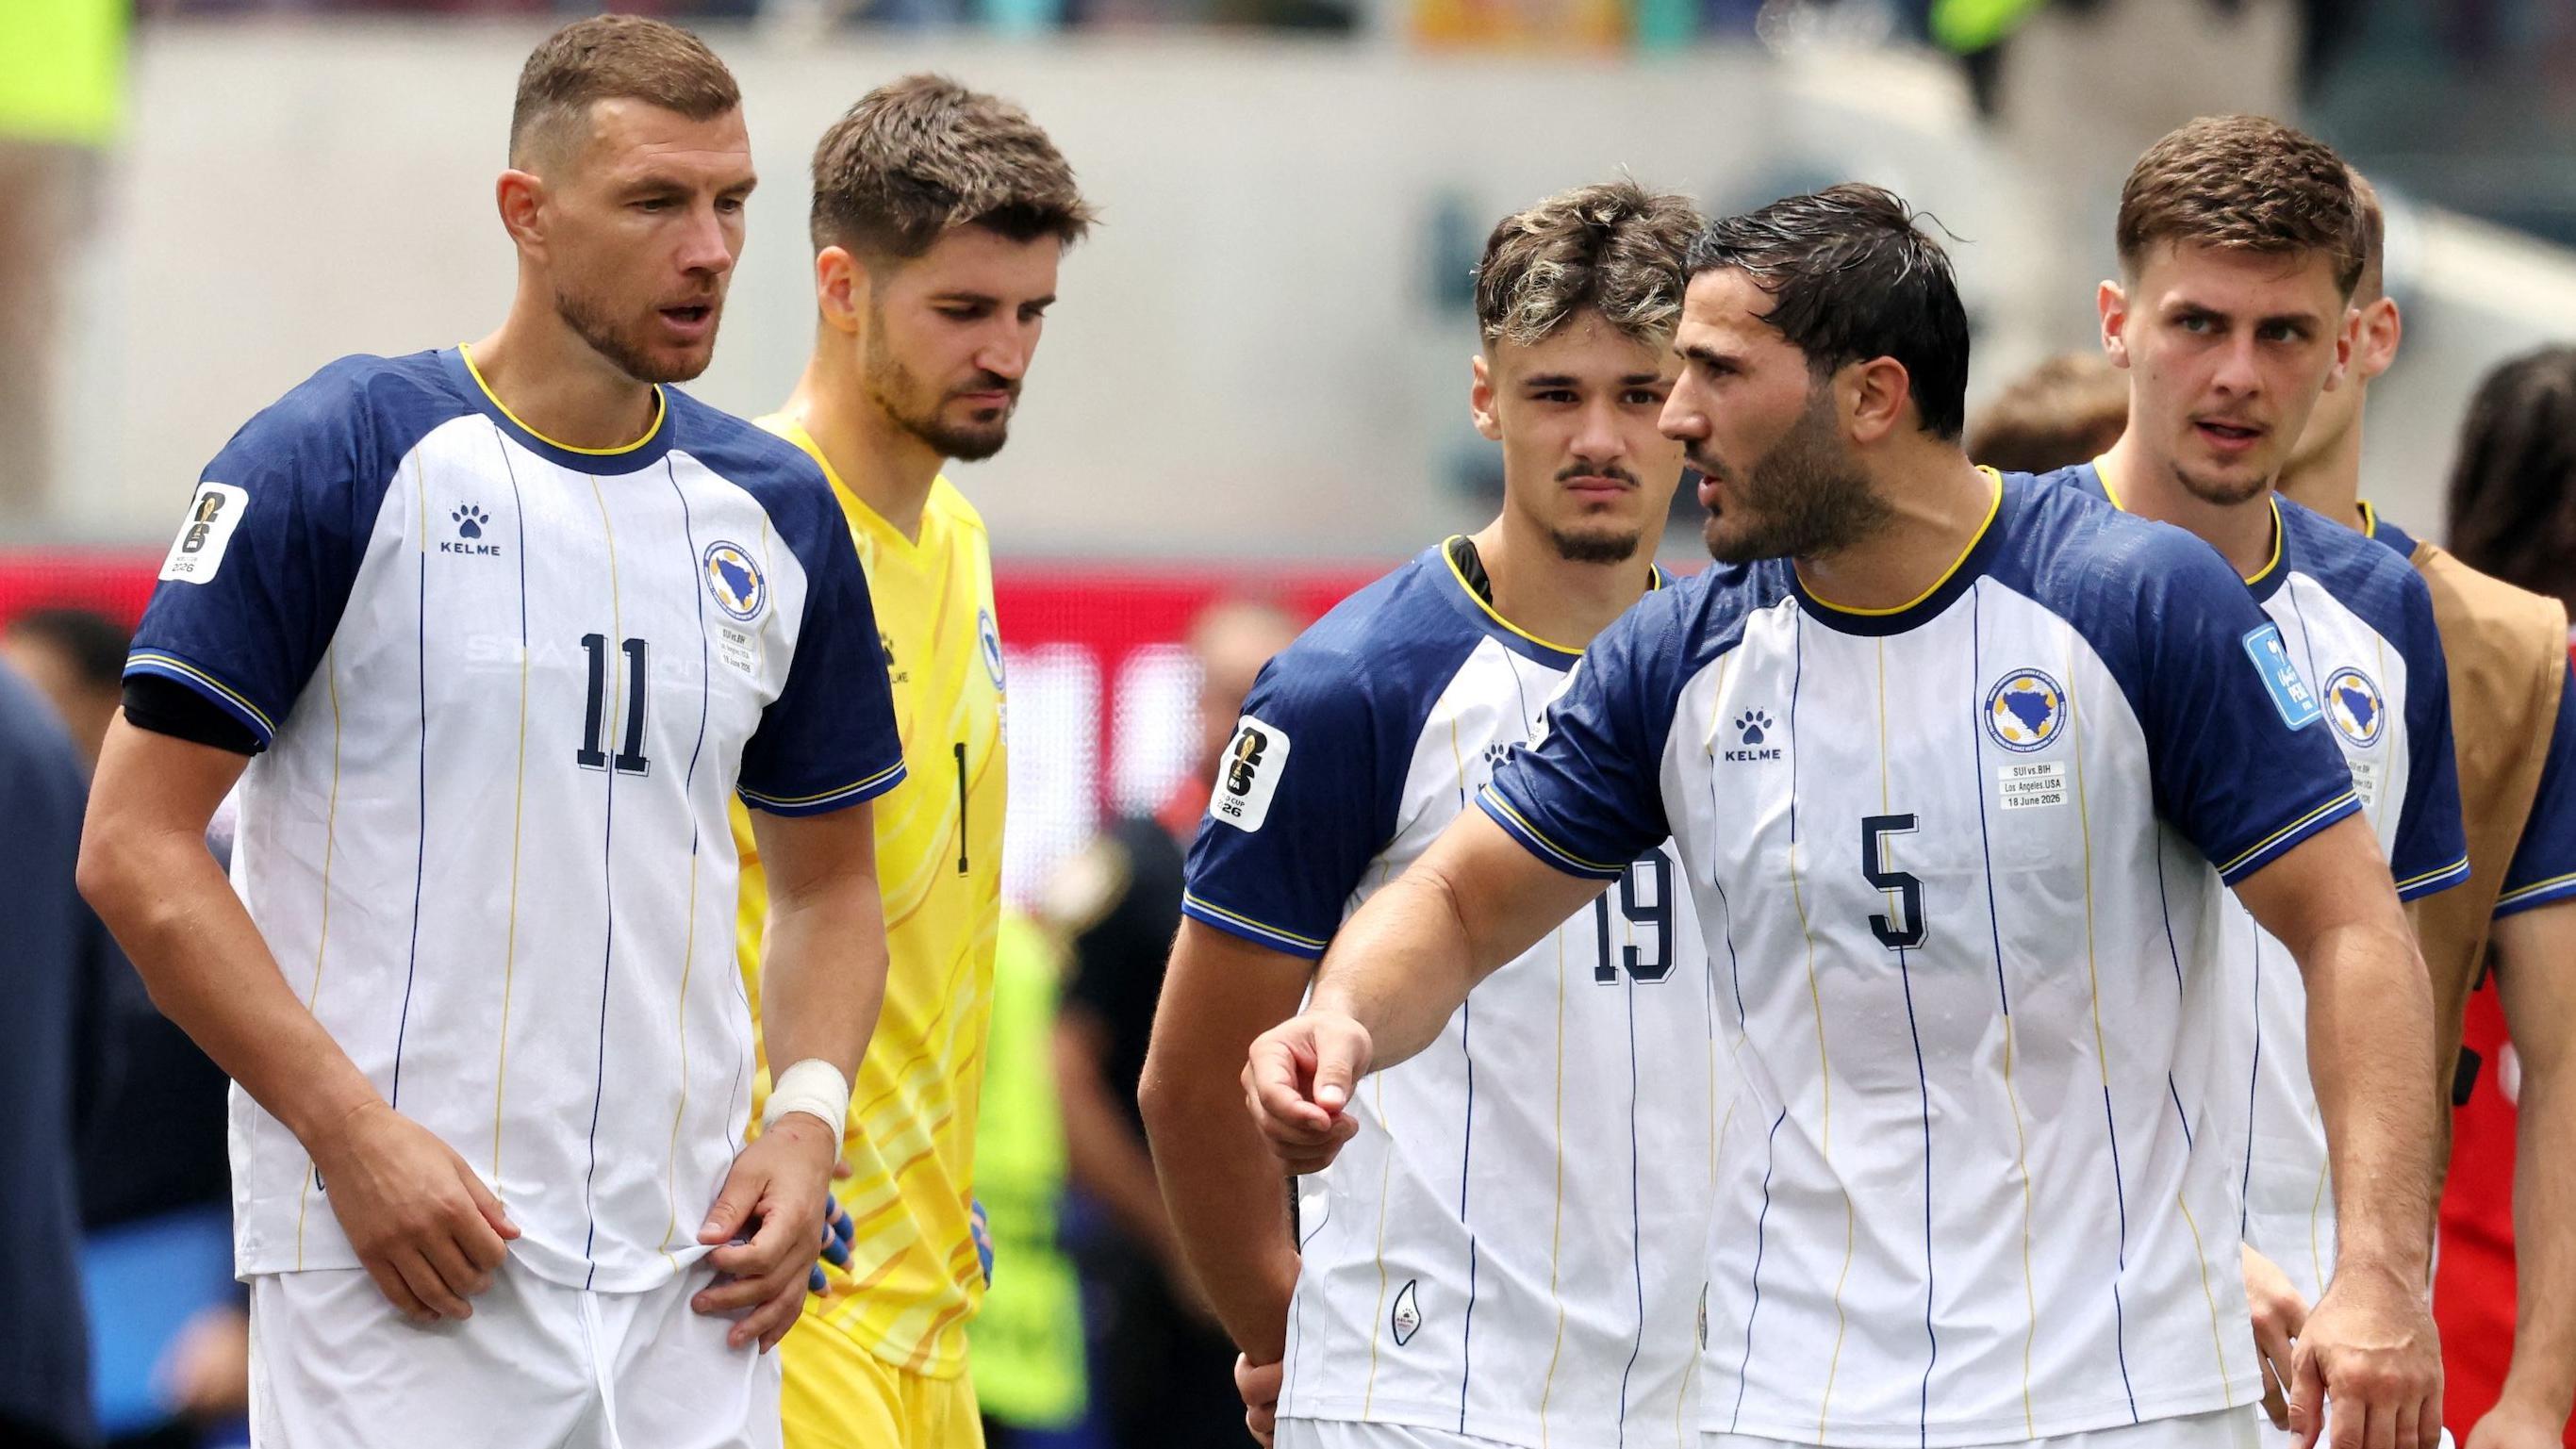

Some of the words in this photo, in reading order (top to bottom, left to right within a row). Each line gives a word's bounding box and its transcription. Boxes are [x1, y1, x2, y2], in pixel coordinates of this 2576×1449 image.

[440, 541, 501, 556] KELME
[577, 634, 651, 777] 11
[1725, 749, 1781, 762] KELME
[2013, 766, 2027, 777] SUI
[2005, 783, 2016, 793] Los
[1230, 798, 1246, 807] CUP
[2008, 798, 2019, 807] 18
[2021, 797, 2039, 806] June
[2040, 793, 2061, 804] 2026
[953, 742, 968, 878] 1
[1862, 814, 1928, 951] 5
[1594, 847, 1676, 985] 19
